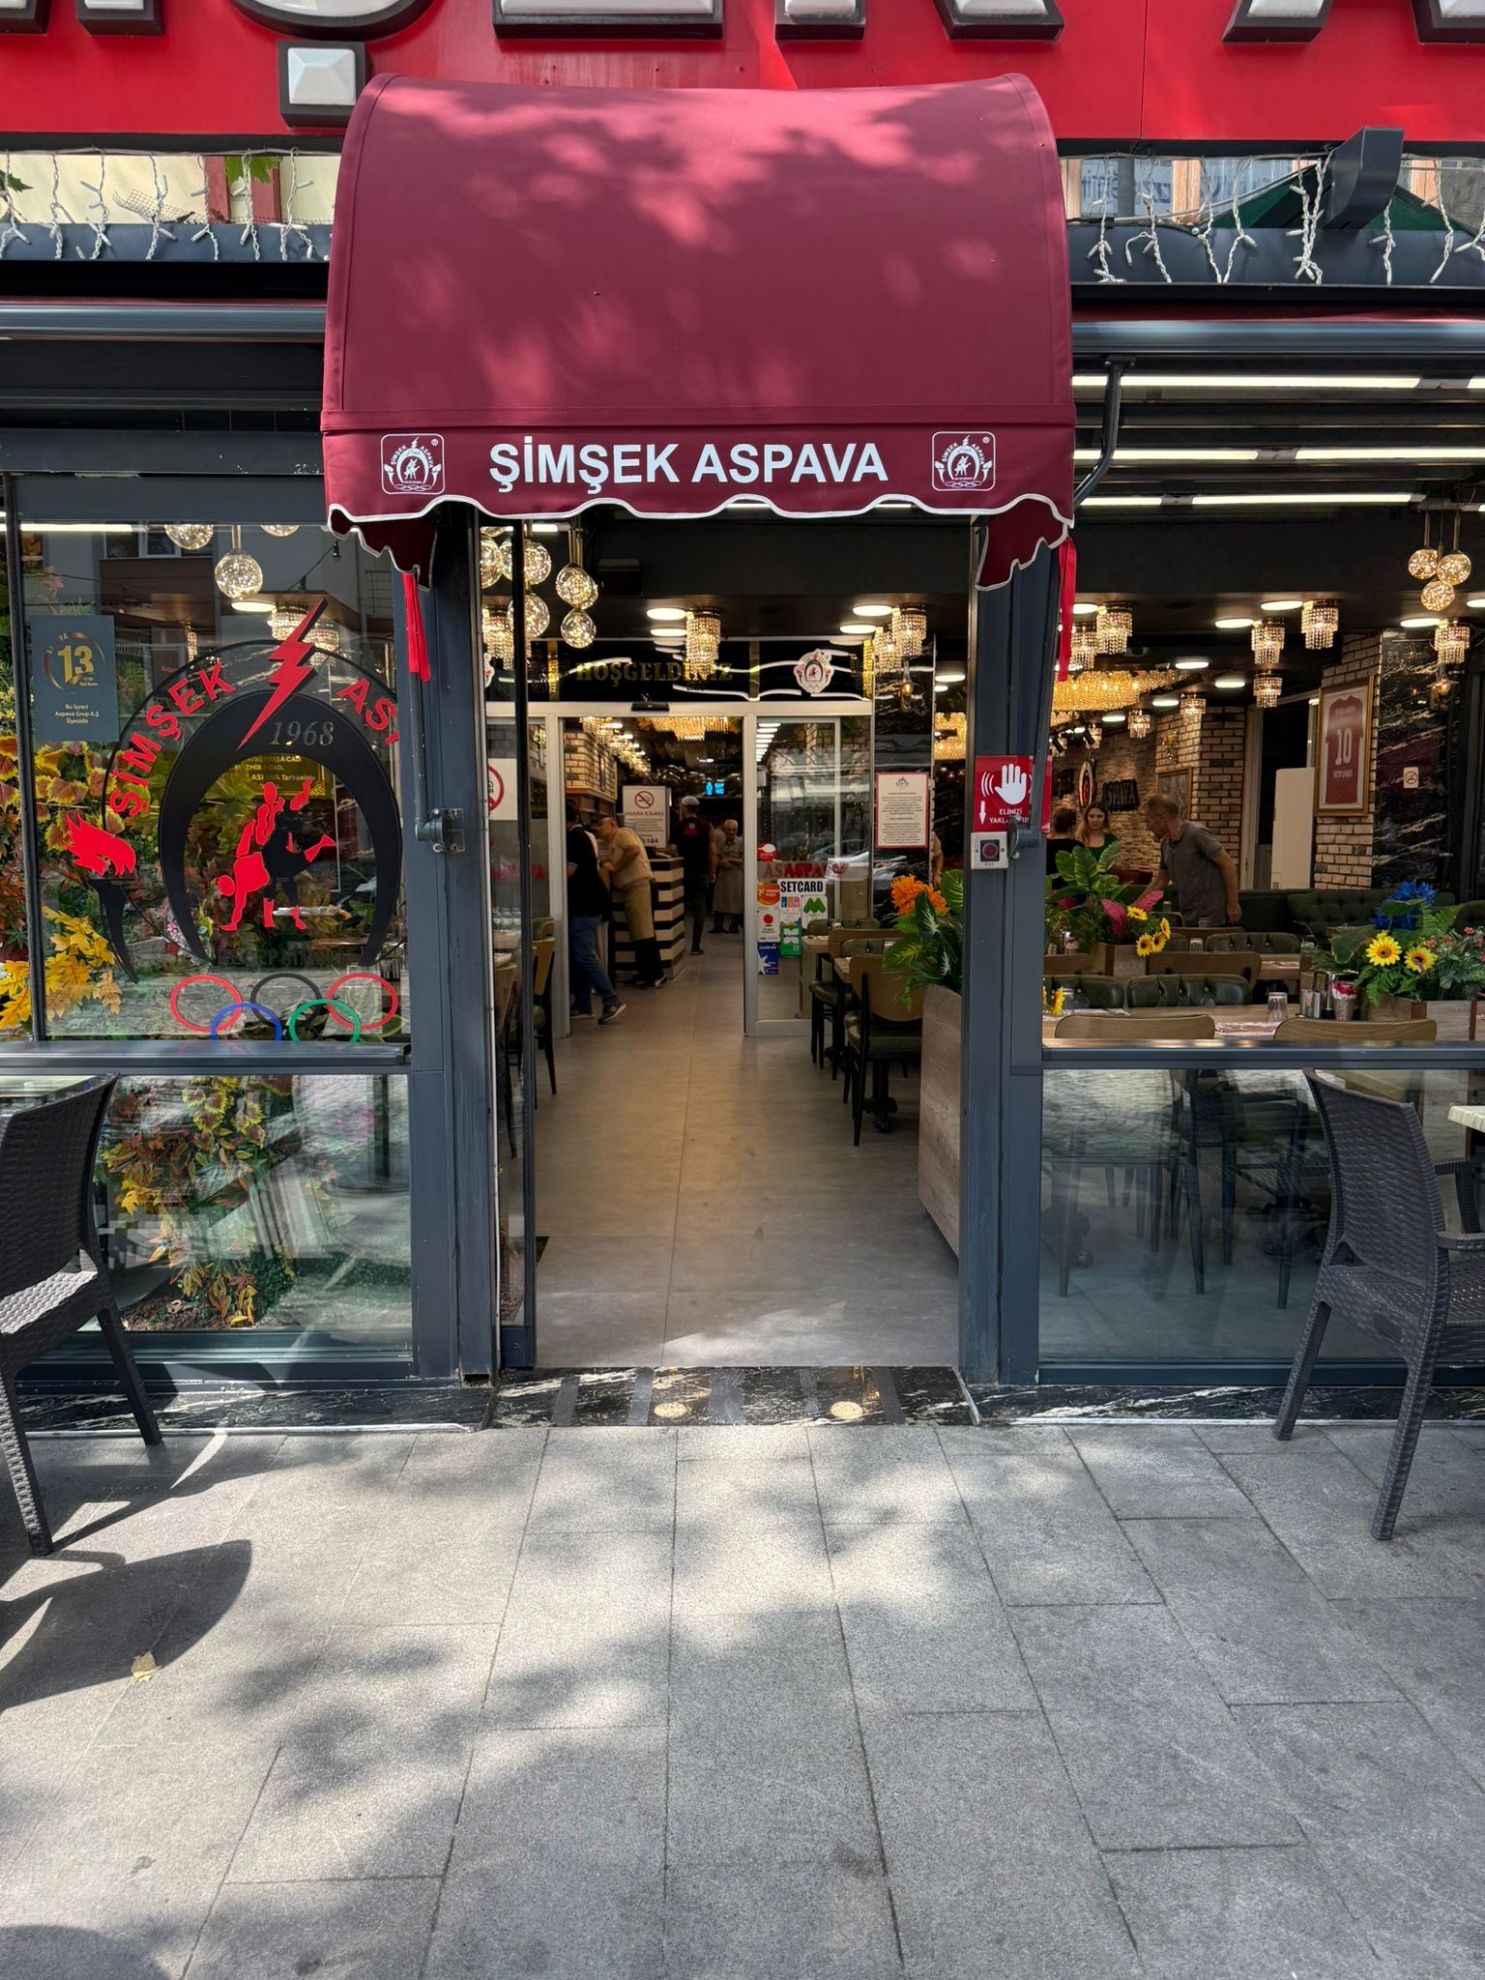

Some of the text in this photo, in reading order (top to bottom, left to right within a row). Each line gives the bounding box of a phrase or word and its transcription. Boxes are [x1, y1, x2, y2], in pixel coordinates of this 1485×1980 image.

[489, 435, 889, 495] ŞİMŞEK ASPAVA
[57, 645, 94, 684] 13
[110, 662, 236, 817] ŞİMŞEK
[268, 720, 335, 746] 1968
[1335, 727, 1353, 766] 10
[780, 881, 824, 893] SETCARD
